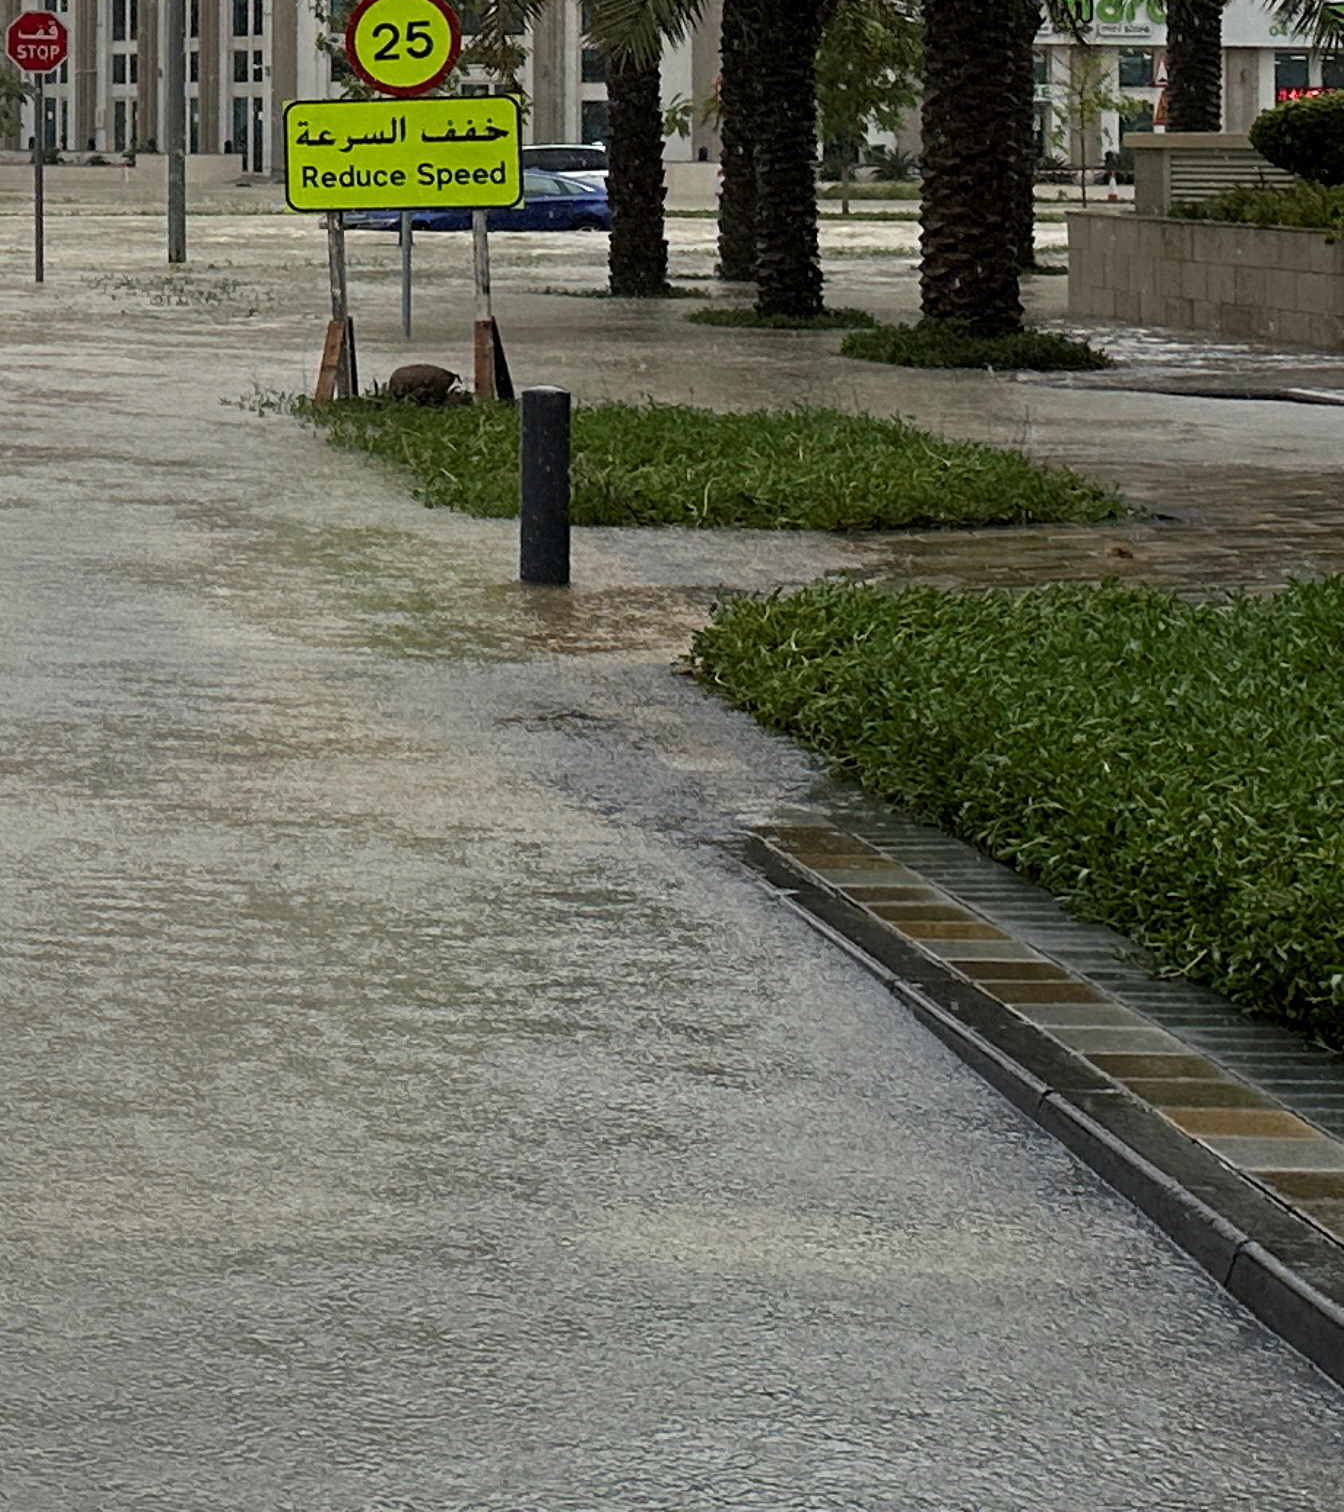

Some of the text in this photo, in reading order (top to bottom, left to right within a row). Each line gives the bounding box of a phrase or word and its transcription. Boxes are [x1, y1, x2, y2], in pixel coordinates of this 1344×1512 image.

[18, 20, 59, 39] قف
[372, 20, 434, 61] 25
[16, 44, 60, 61] STOP
[295, 115, 510, 153] خفف السرعة
[302, 160, 507, 191] Reduce Speed
